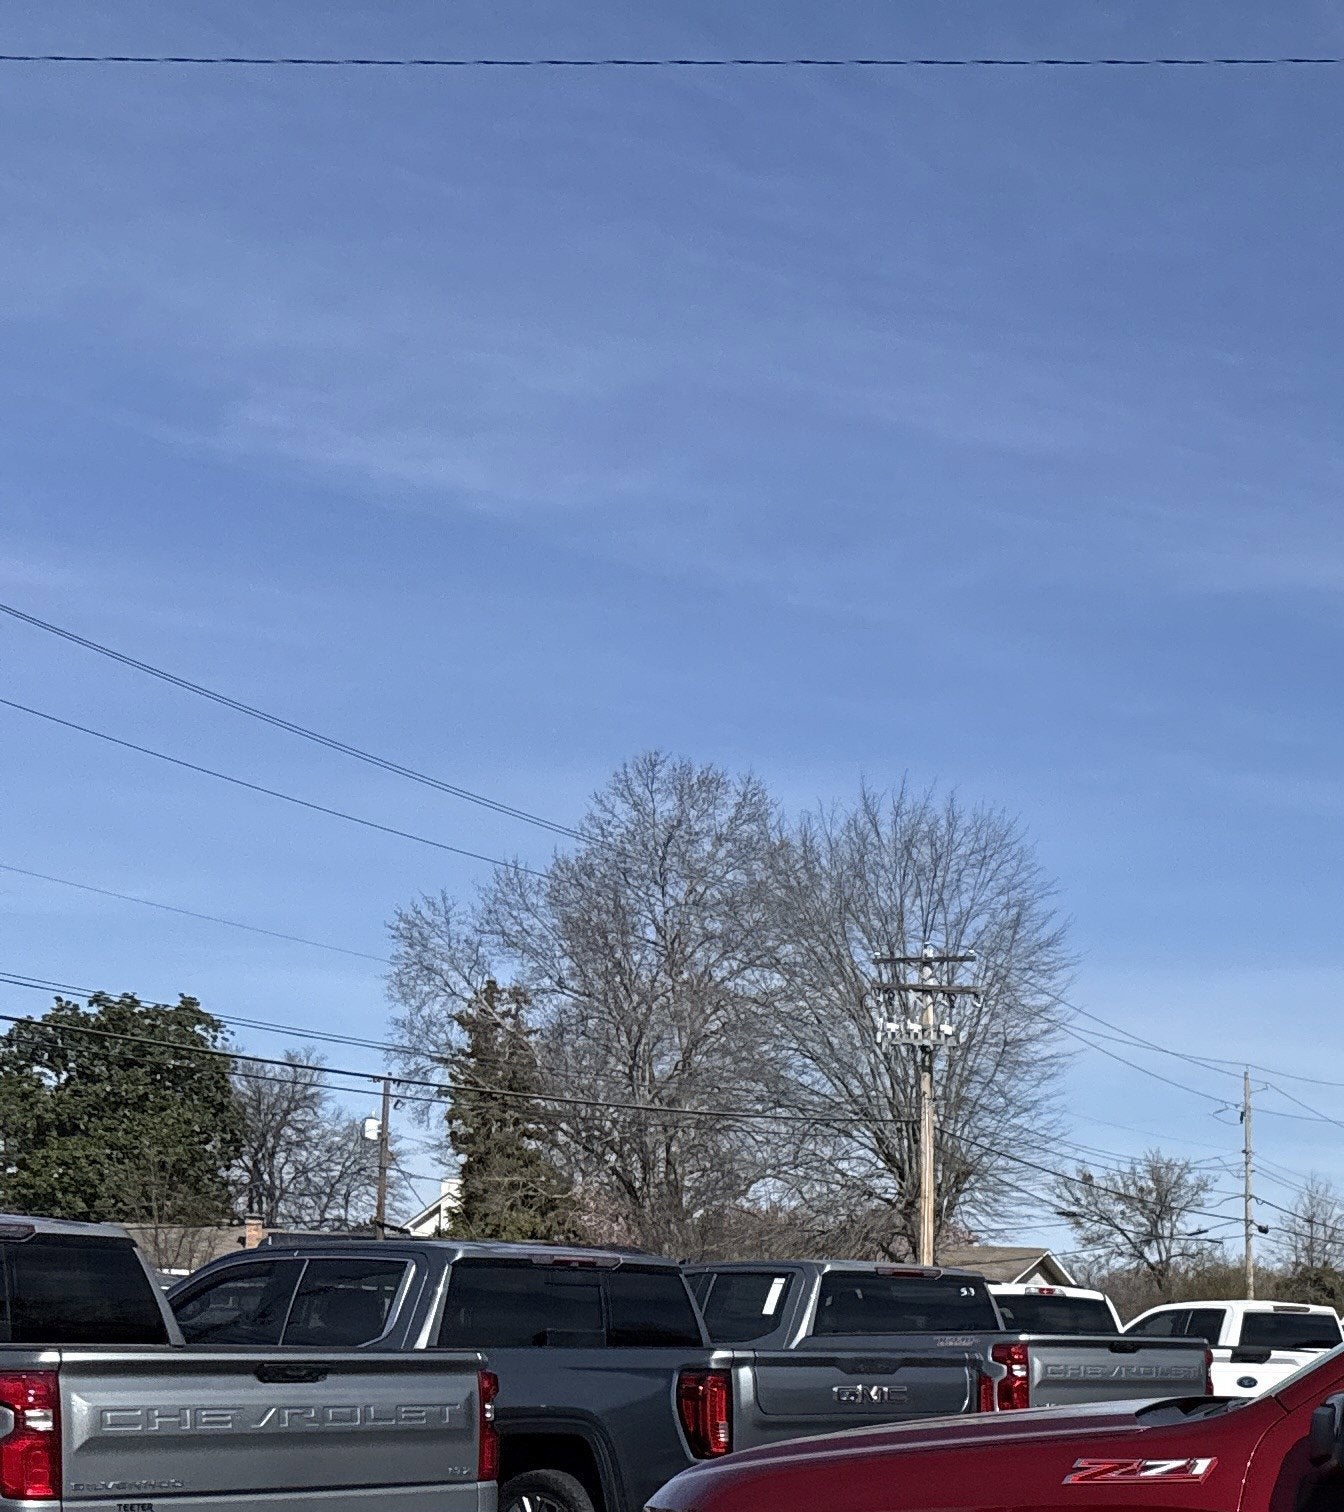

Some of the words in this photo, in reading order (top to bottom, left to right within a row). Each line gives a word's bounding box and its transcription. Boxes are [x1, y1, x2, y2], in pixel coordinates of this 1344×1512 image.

[1046, 1364, 1198, 1378] CHEVROLET
[832, 1384, 908, 1404] GMC
[100, 1402, 462, 1431] CHEVROLET
[1062, 1456, 1218, 1485] Z71
